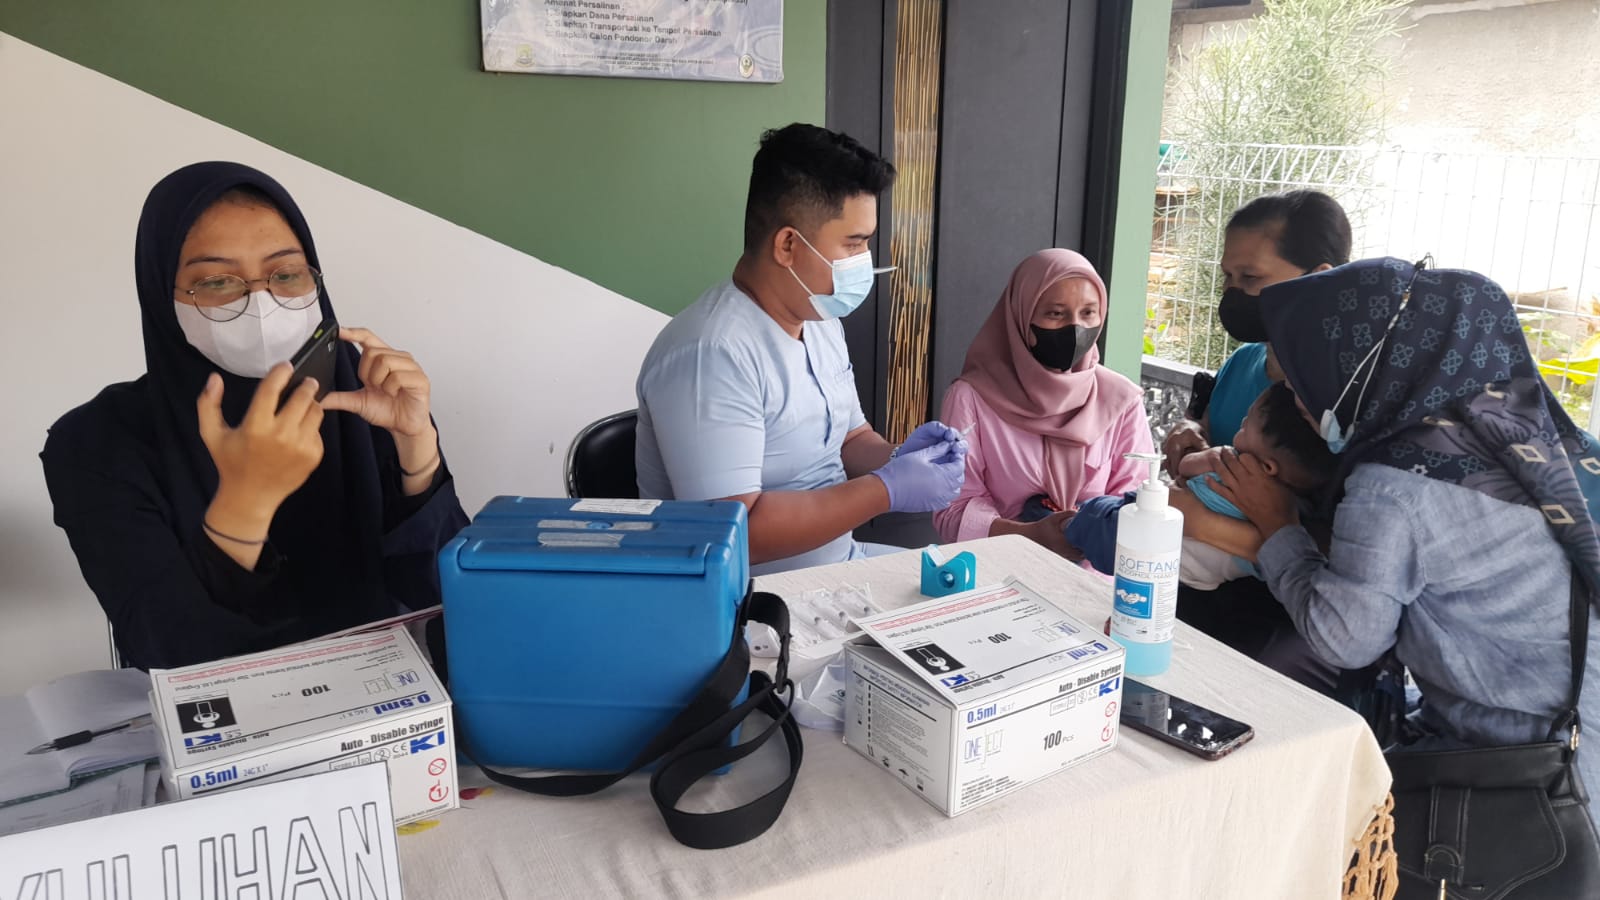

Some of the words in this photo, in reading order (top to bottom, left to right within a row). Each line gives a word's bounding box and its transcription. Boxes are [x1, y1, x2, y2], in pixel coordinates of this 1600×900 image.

[589, 11, 610, 20] Dana
[590, 22, 640, 32] Transportasi
[590, 32, 612, 41] Calon
[987, 632, 1012, 644] 100
[301, 685, 331, 697] 100
[1059, 682, 1073, 694] Auto
[1077, 673, 1100, 687] Disable
[1098, 677, 1121, 697] KI
[374, 694, 431, 715] 0.5ml
[967, 704, 997, 723] 0.5ml
[184, 733, 222, 747] KI
[341, 738, 363, 752] Auto
[371, 727, 407, 744] Disable
[409, 716, 445, 735] Syringe
[410, 731, 446, 754] KI
[1044, 730, 1062, 752] 100
[190, 766, 239, 790] 0.5ml
